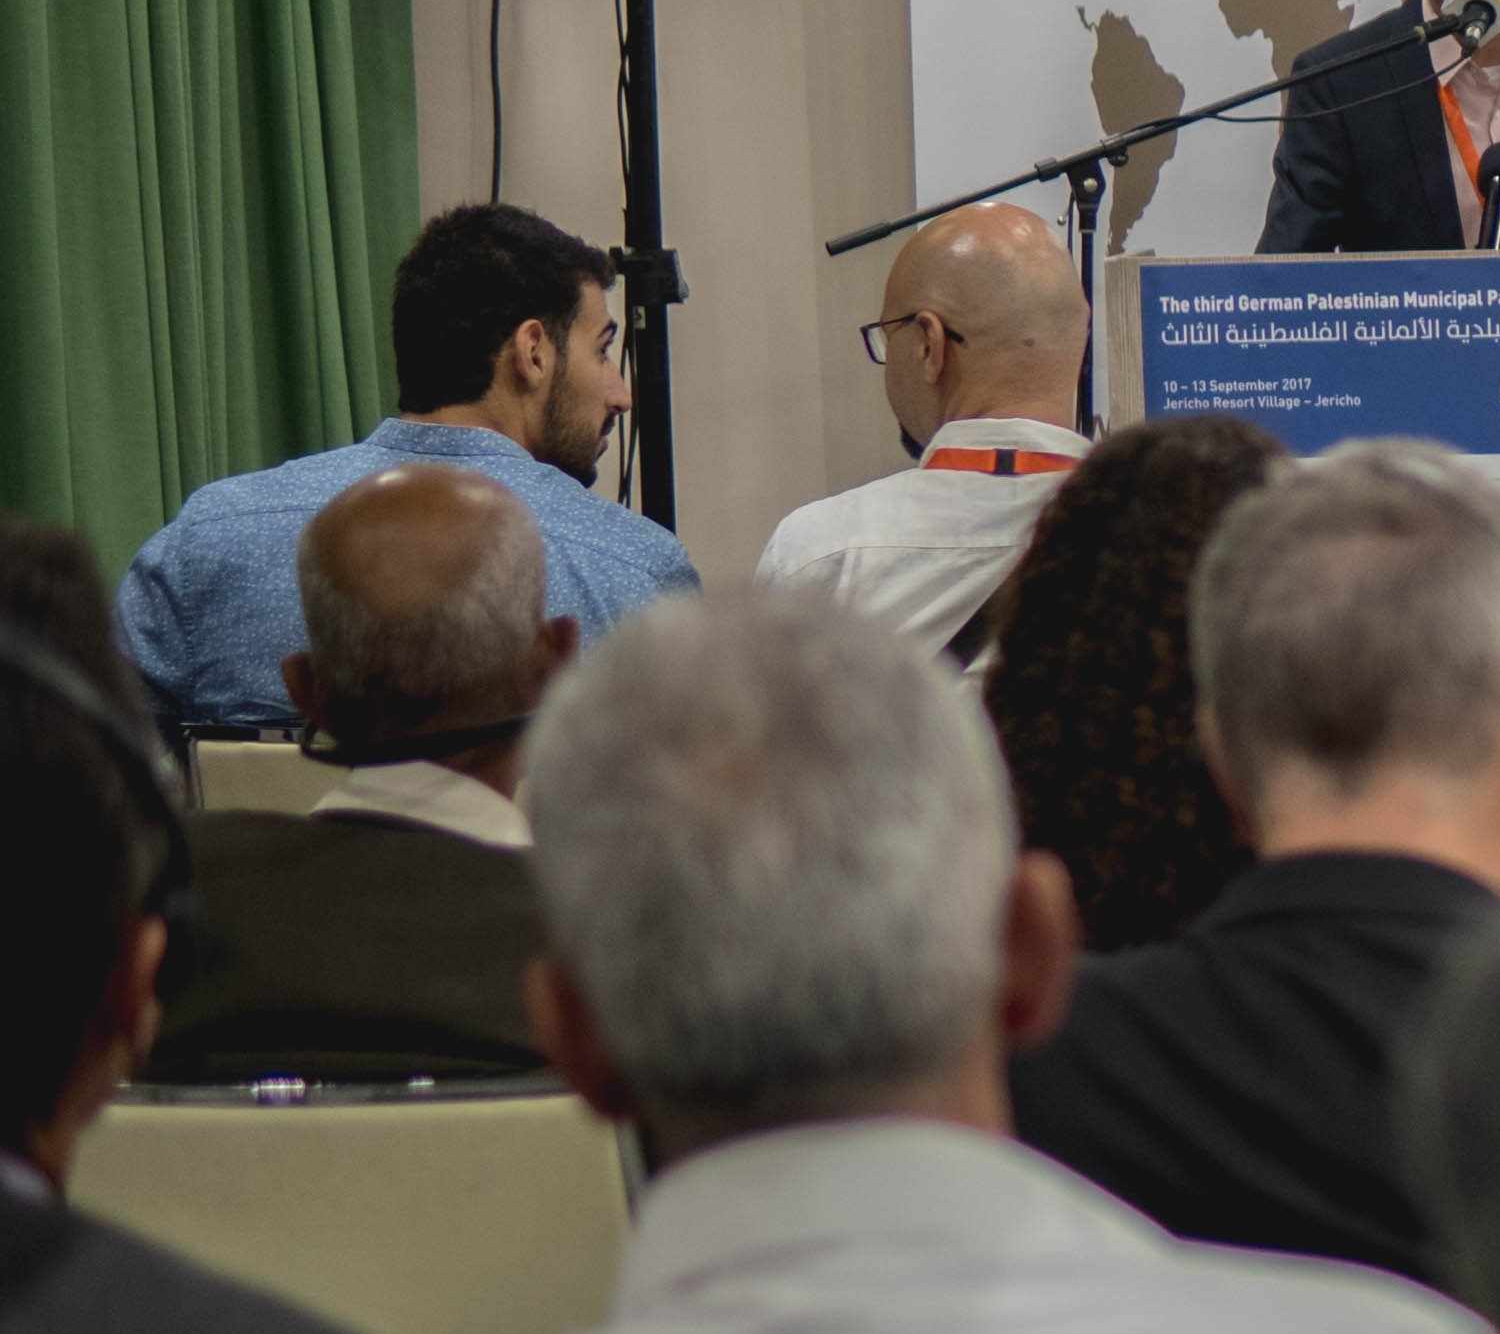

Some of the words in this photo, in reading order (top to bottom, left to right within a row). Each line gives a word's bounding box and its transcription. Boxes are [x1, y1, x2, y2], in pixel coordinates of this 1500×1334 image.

[1159, 296, 1191, 314] The
[1193, 294, 1235, 313] third
[1237, 294, 1304, 312] German
[1306, 291, 1400, 311] Palestinian
[1403, 289, 1484, 311] Municipal
[1161, 321, 1219, 346] الثالث
[1225, 320, 1348, 349] الفلسطينية
[1353, 316, 1441, 346] الألمانية
[1163, 380, 1178, 394] 10
[1192, 379, 1207, 393] 13
[1209, 379, 1279, 396] September
[1281, 377, 1312, 391] 2017
[1163, 397, 1211, 410] Jericho
[1212, 396, 1255, 409] Resort
[1257, 395, 1301, 411] Village
[1314, 393, 1362, 408] Jericho
